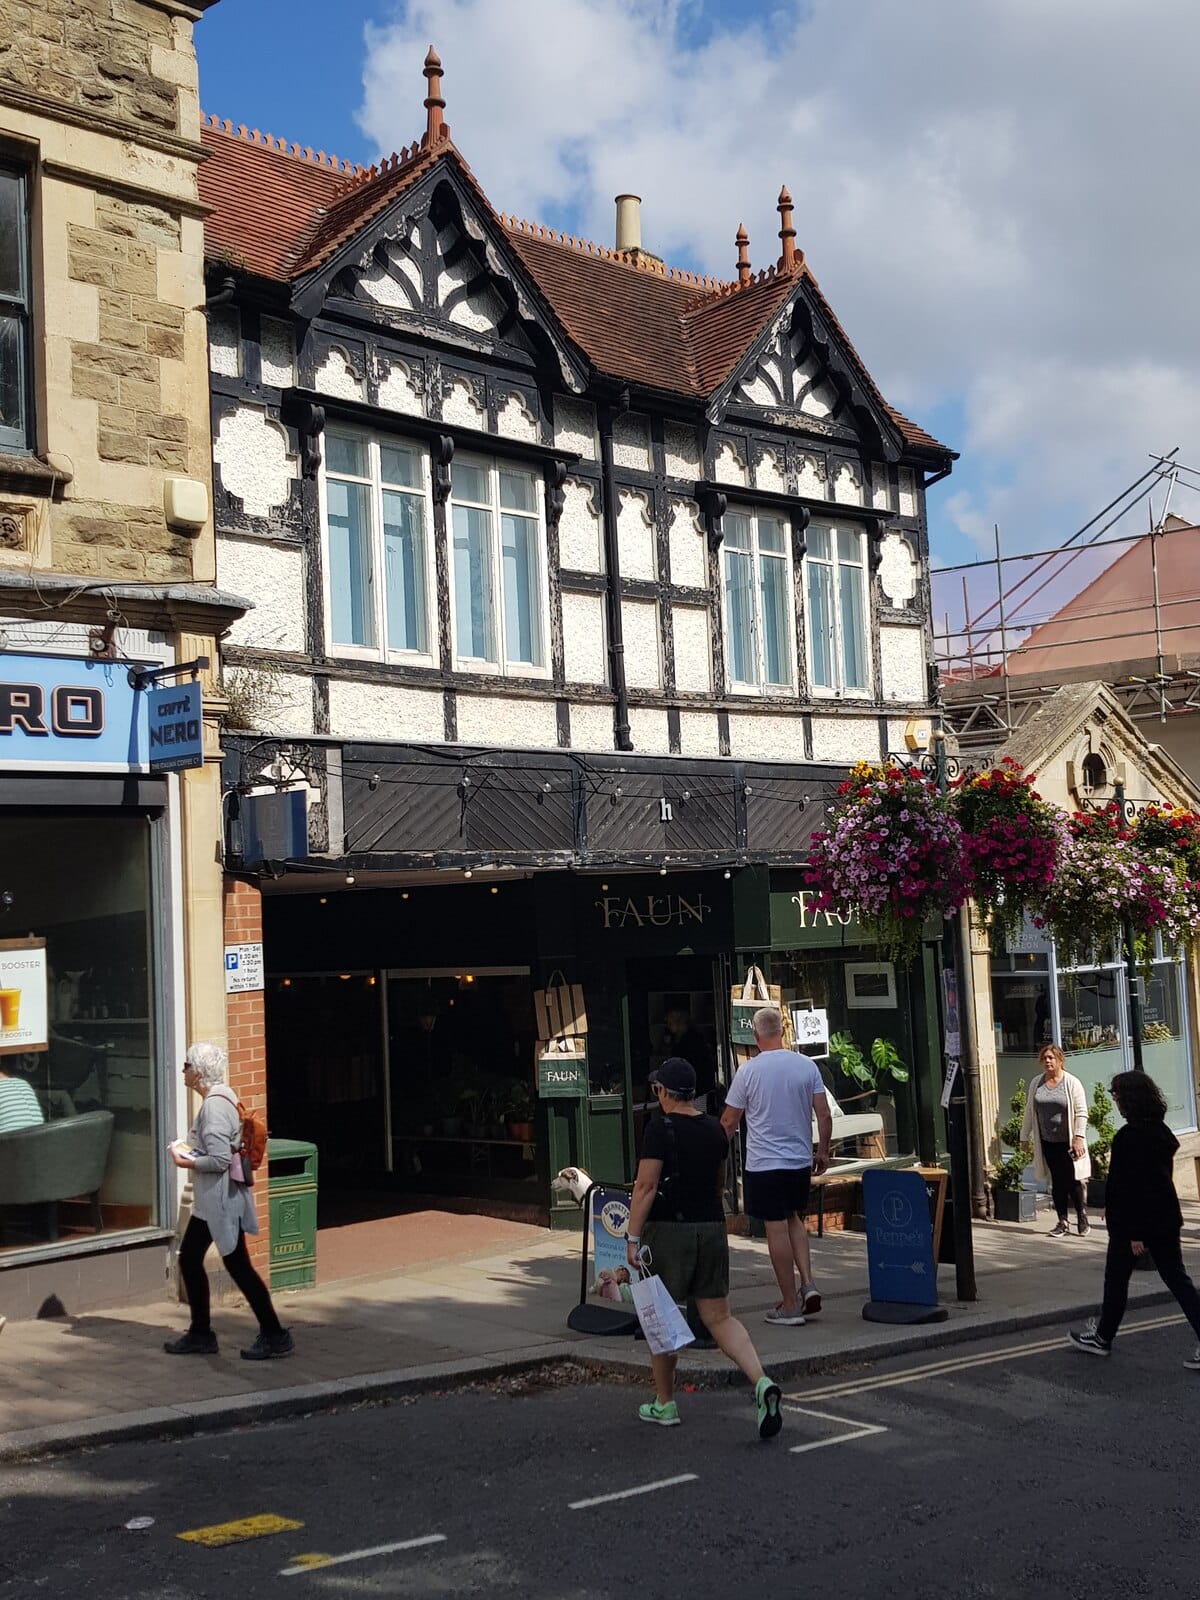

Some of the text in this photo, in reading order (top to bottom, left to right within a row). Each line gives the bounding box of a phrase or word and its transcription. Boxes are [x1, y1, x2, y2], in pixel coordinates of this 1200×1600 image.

[150, 720, 199, 747] NERO
[660, 797, 673, 820] h
[594, 892, 712, 928] FAUN
[791, 890, 861, 928] FAU
[1, 960, 41, 970] BOOSTER
[228, 955, 237, 968] P
[738, 1018, 753, 1029] FA
[546, 1070, 579, 1081] FAUN
[889, 1197, 903, 1221] P
[274, 1242, 304, 1256] LITTER
